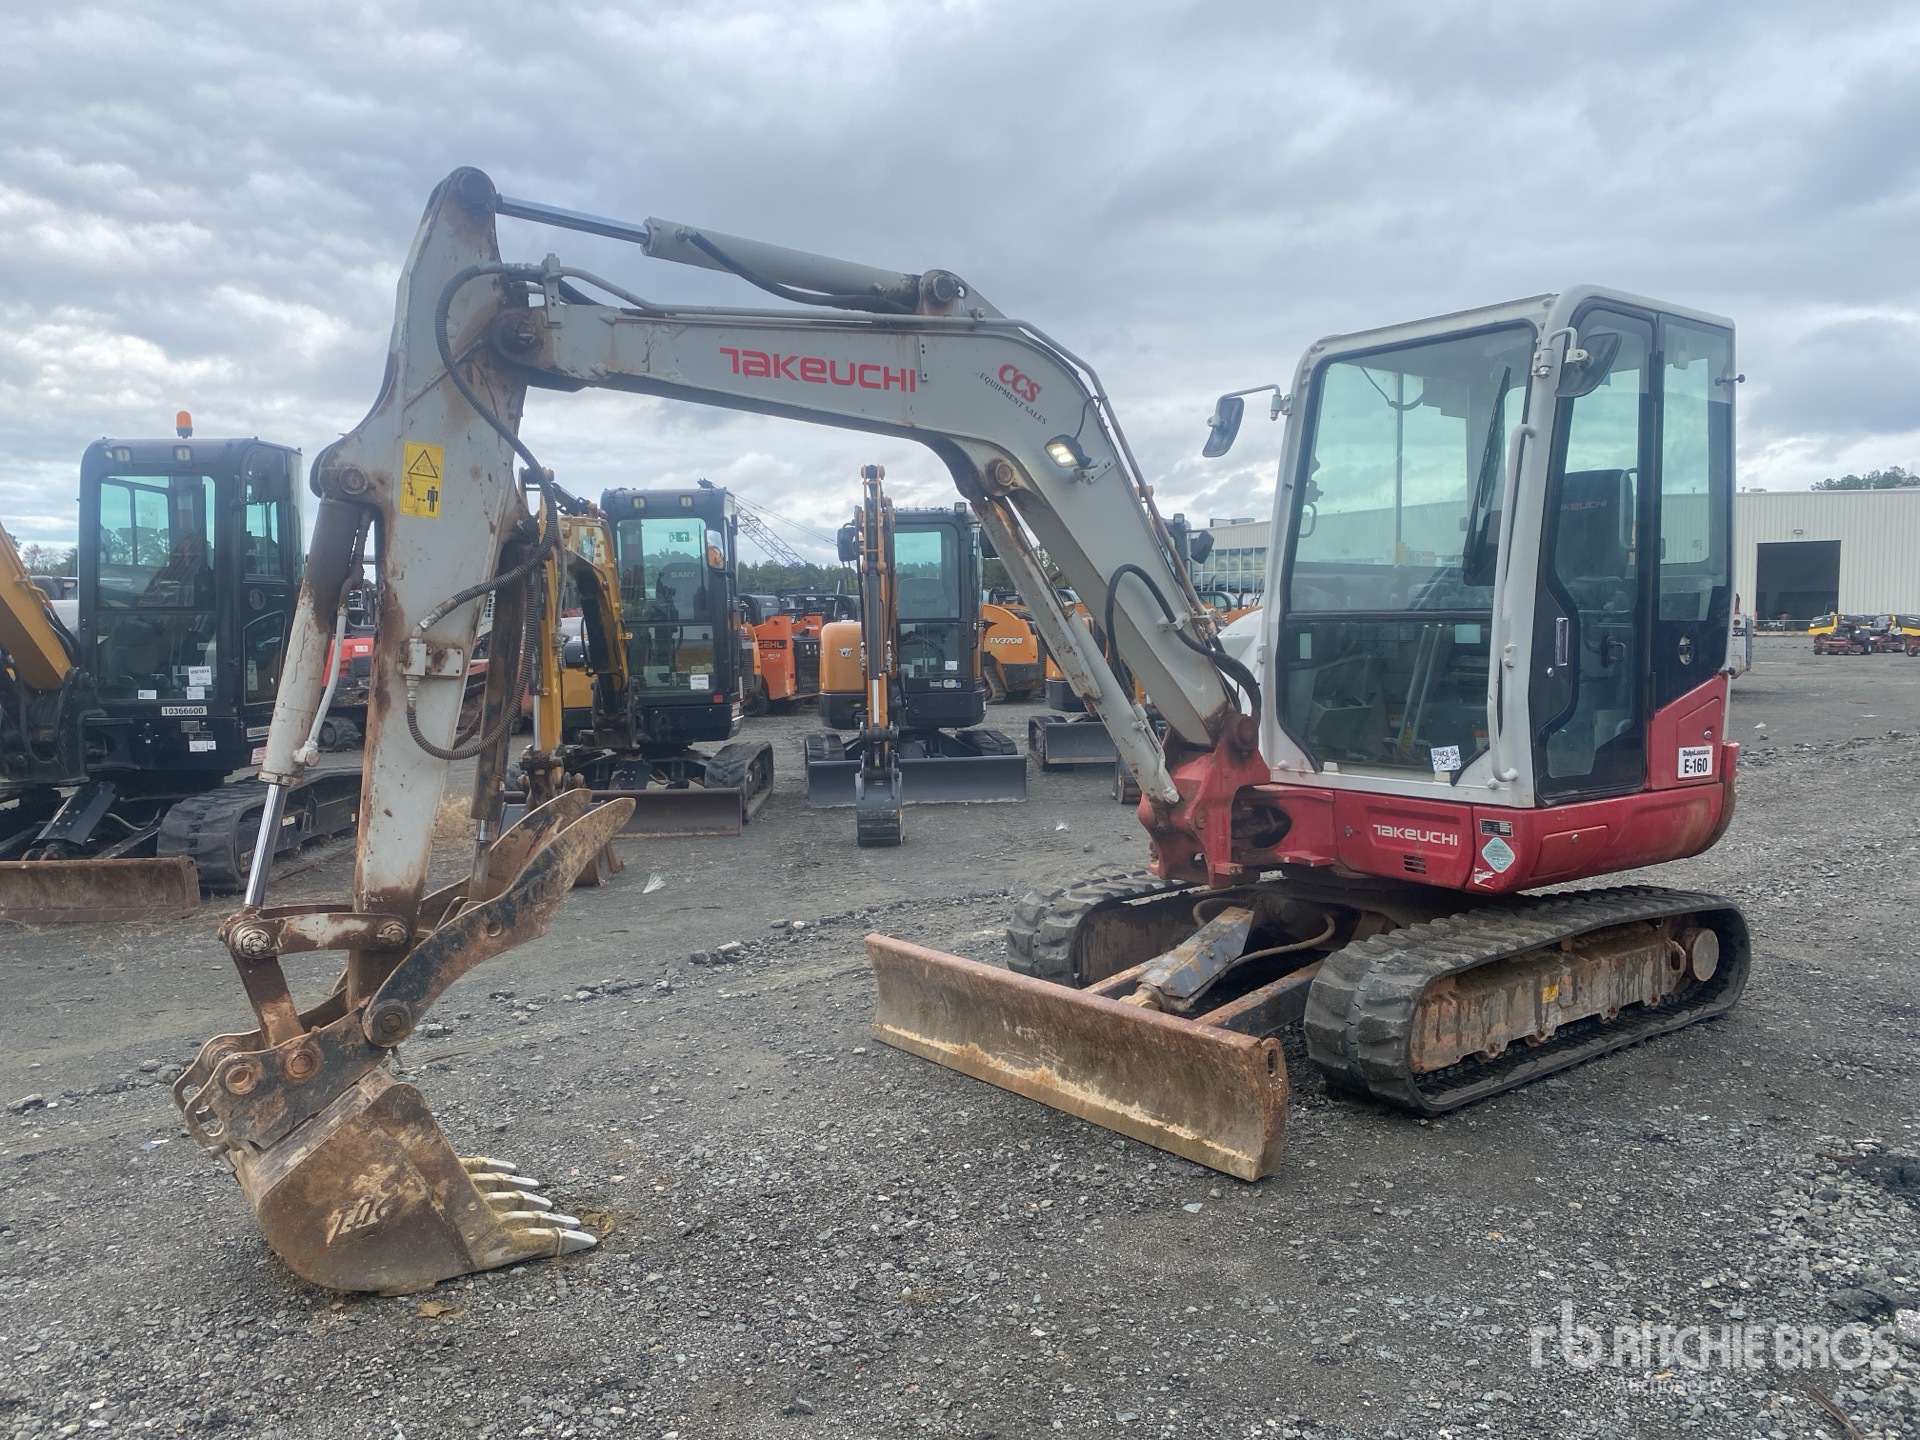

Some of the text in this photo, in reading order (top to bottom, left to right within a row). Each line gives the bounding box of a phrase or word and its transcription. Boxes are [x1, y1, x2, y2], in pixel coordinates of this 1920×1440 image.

[719, 347, 916, 393] TAKEUCHI
[997, 363, 1043, 404] CCS
[979, 371, 1048, 425] EQUIPMENT SALES
[1560, 500, 1607, 511] KEUCHI
[164, 707, 204, 715] 10366600
[1684, 757, 1708, 774] E-160
[1372, 824, 1458, 846] TAKEUCHI
